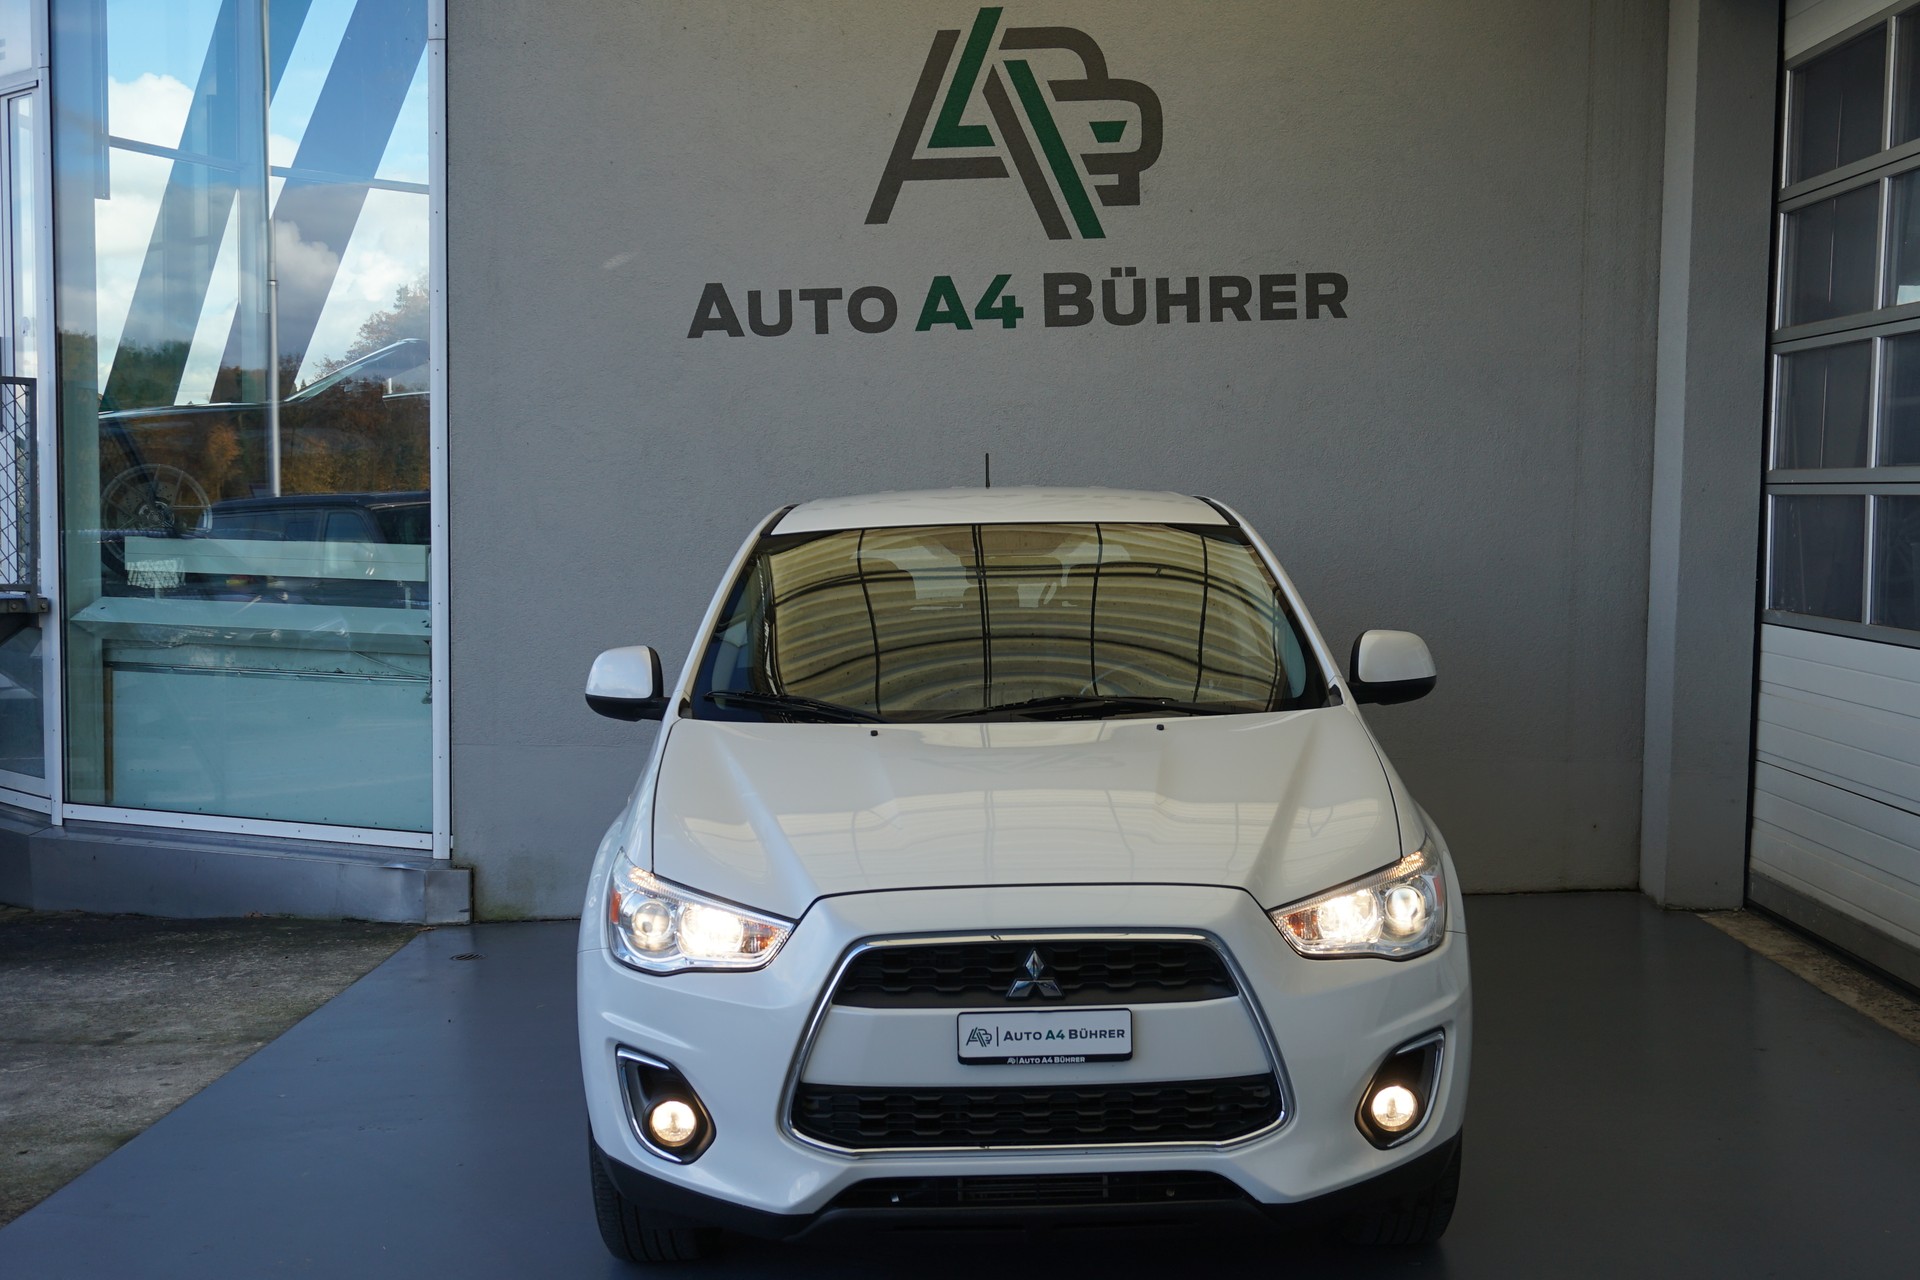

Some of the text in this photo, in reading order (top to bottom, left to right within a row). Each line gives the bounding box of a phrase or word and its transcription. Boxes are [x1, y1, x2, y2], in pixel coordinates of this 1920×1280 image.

[687, 267, 1349, 338] AUTO A4 BÜHRER
[1003, 1030, 1042, 1041] AUTO
[1045, 1029, 1065, 1040] A4
[1068, 1028, 1125, 1040] BÜHRER
[1041, 1056, 1053, 1064] A4
[1054, 1056, 1086, 1064] BÜHRER
